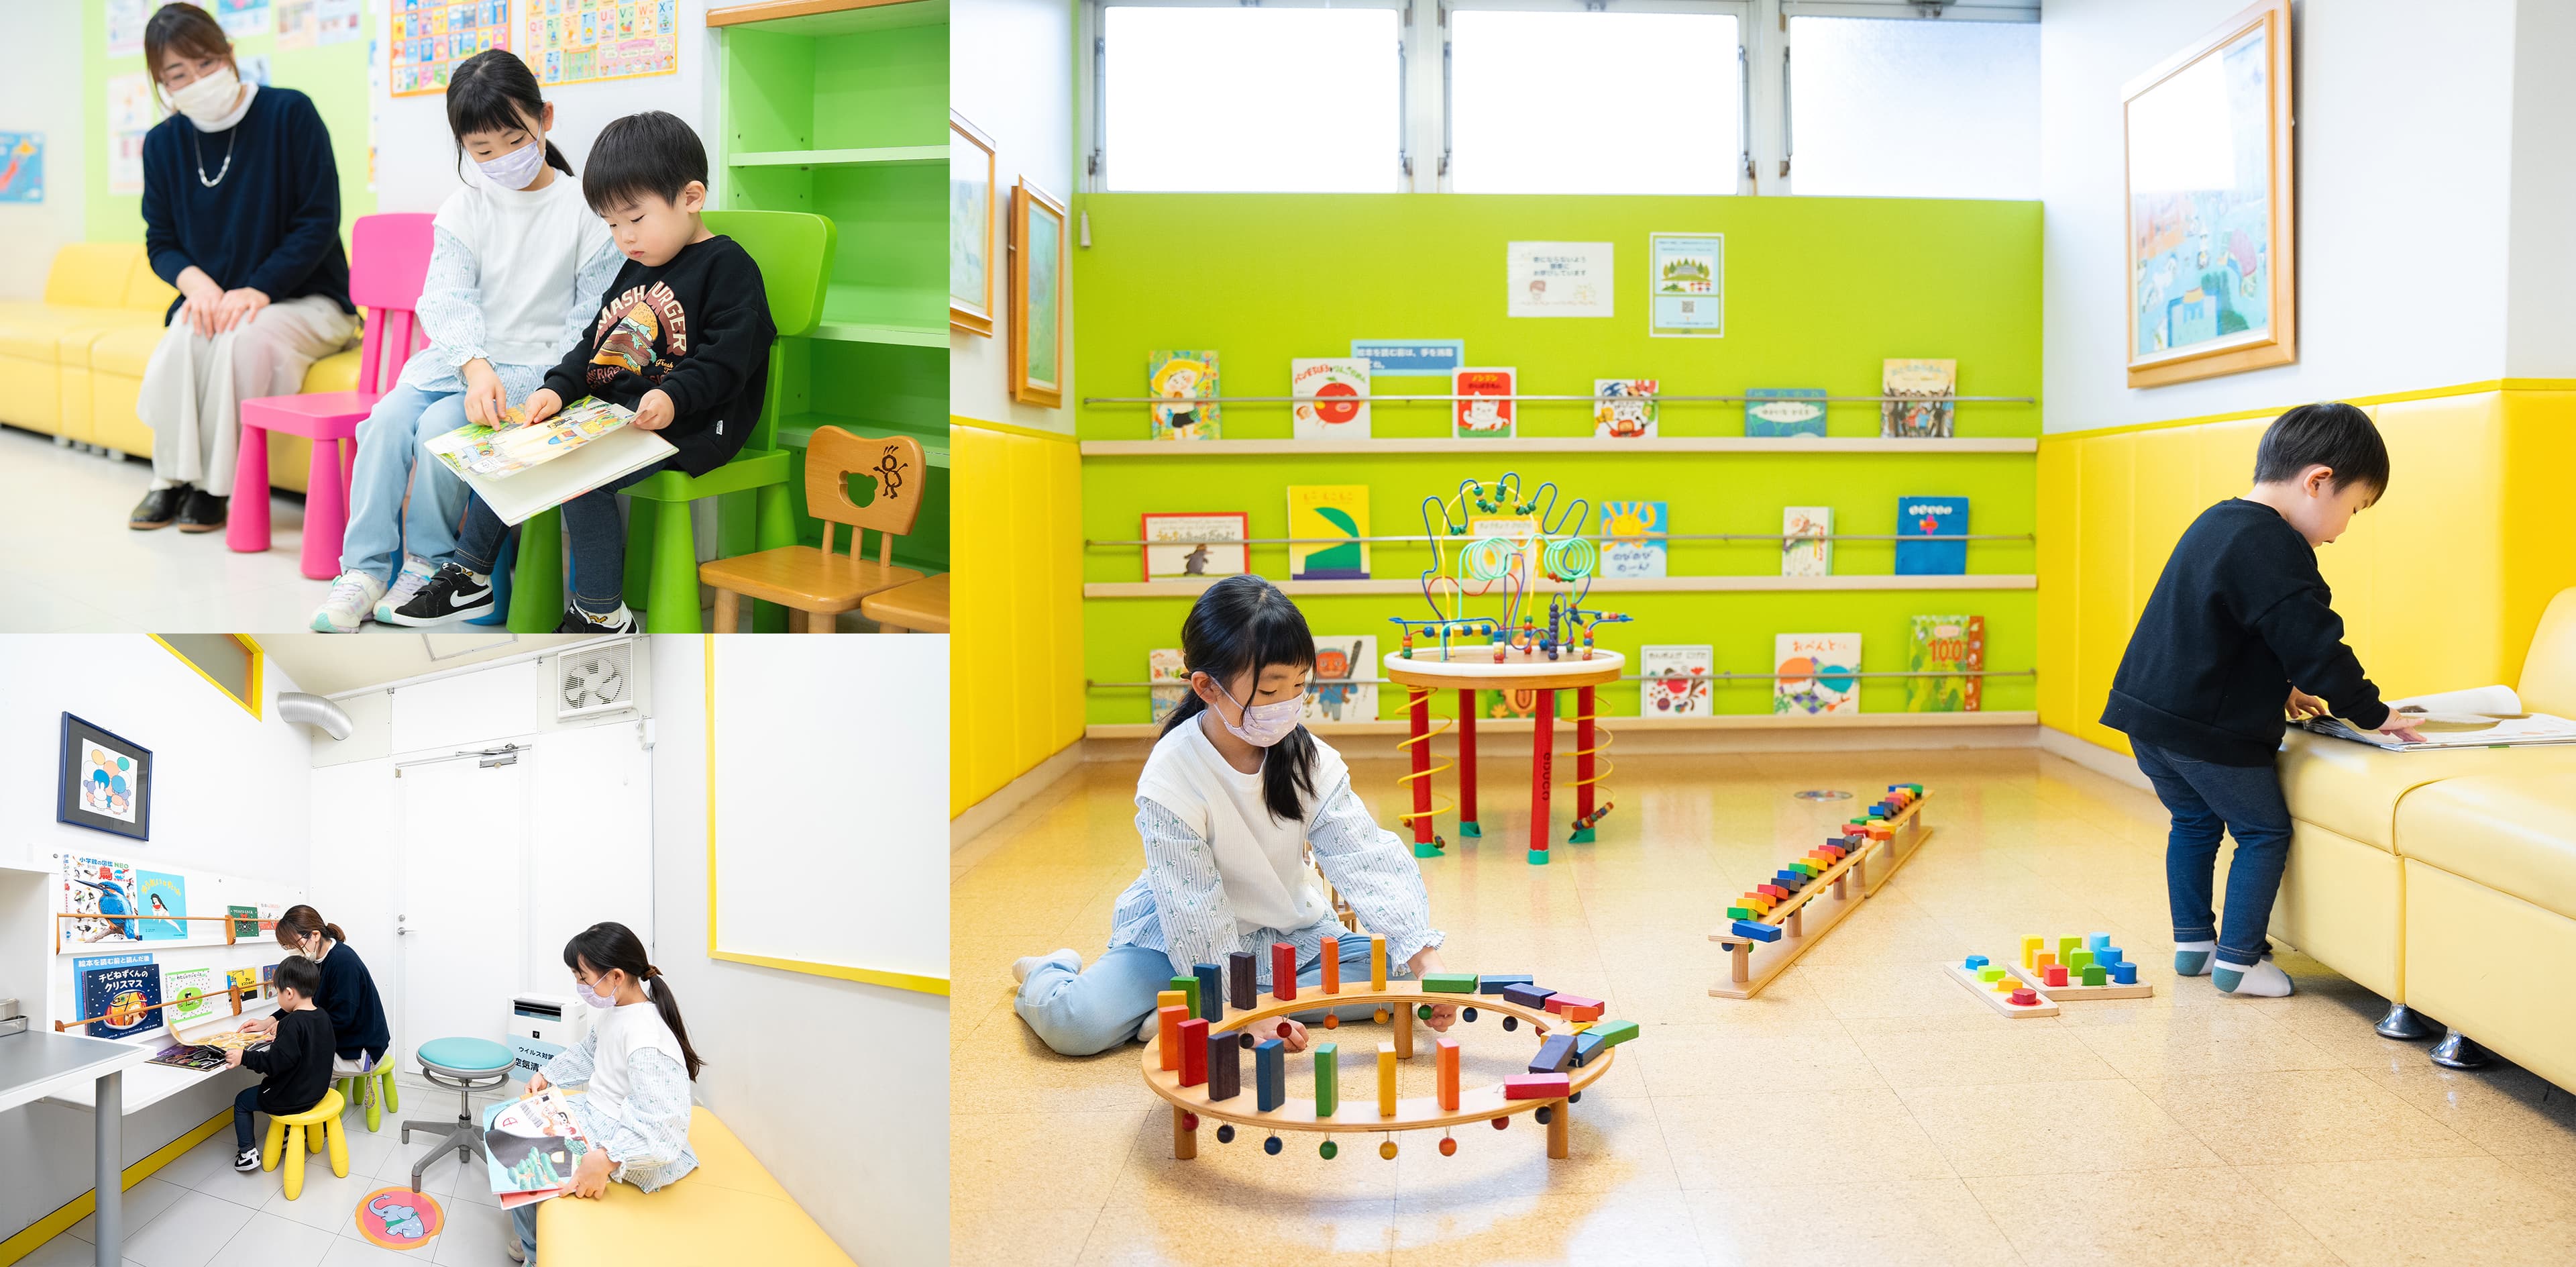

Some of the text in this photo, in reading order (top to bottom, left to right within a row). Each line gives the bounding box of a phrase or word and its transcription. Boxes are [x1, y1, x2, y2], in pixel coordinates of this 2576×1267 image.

[619, 9, 627, 18] V
[659, 3, 666, 13] X
[597, 280, 687, 352] MASH URGER
[655, 358, 674, 368] Fresh
[1927, 639, 1964, 662] 100
[78, 956, 150, 967] 絵本を読む前と読んだ後
[99, 969, 148, 982] チビねずくんの
[105, 979, 143, 993] クリスマス
[515, 1057, 542, 1072] 空気清
